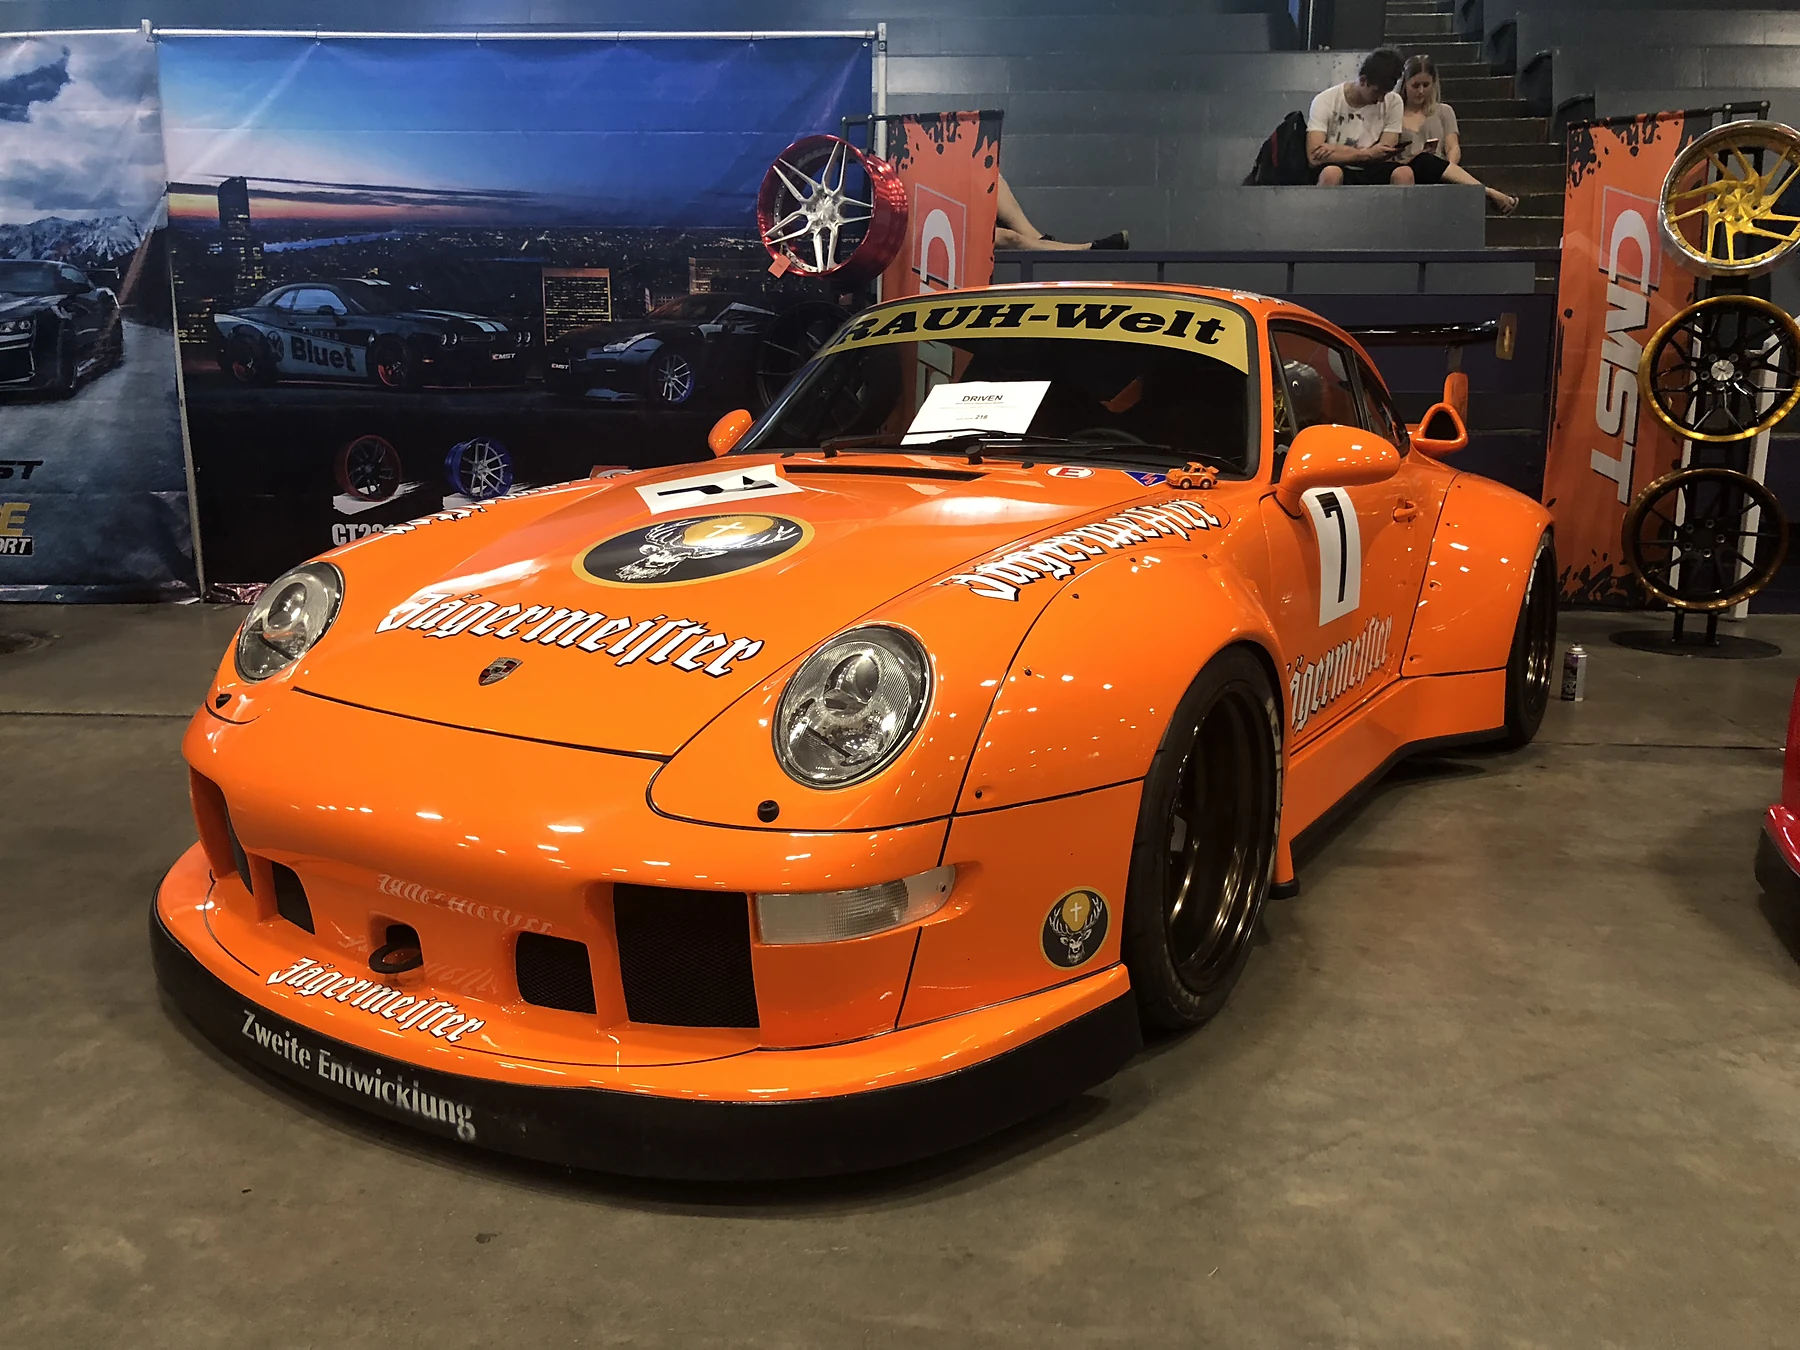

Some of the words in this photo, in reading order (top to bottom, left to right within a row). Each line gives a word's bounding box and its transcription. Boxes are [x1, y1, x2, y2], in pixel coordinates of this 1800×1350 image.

[290, 335, 356, 372] Bluet
[832, 302, 1227, 345] RAUH-Welt
[1591, 209, 1650, 505] CMST
[962, 394, 1004, 402] DRIVEN
[375, 591, 766, 679] Jägermeister
[1287, 611, 1392, 737] ägermeister
[265, 956, 487, 1043] Jägermeister
[241, 1009, 312, 1070] Zweite
[318, 1048, 477, 1142] Entwicklung
